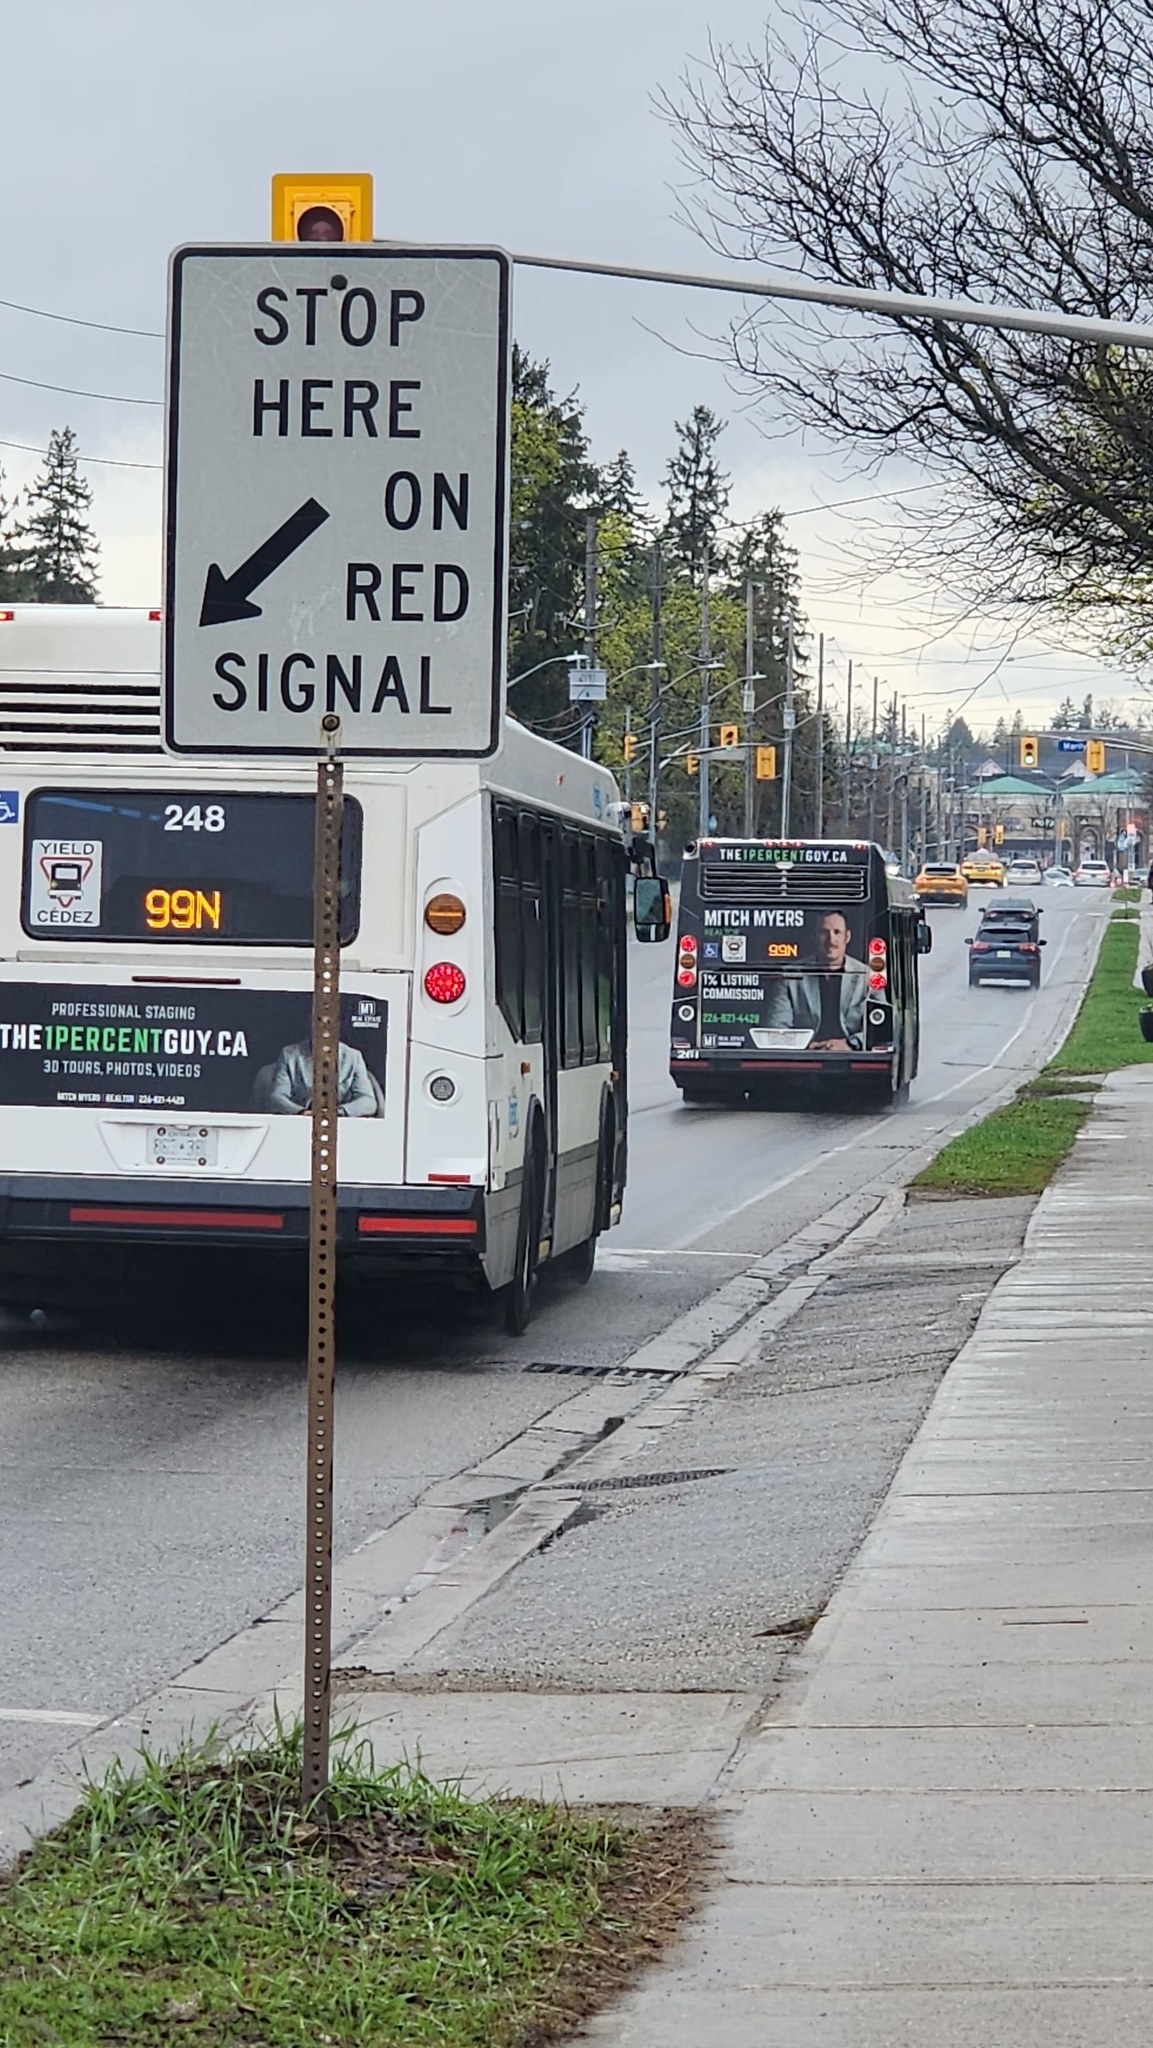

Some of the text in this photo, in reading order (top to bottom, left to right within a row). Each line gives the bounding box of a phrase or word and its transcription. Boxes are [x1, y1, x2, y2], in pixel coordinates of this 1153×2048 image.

[254, 286, 426, 347] STOP
[253, 378, 421, 438] HERE
[384, 471, 469, 531] ON
[346, 563, 470, 622] RED
[212, 651, 453, 714] SIGNAL
[163, 804, 226, 832] 248
[40, 843, 95, 855] YIELD
[719, 848, 848, 863] THE1PERCENTGUY.CA
[37, 908, 94, 924] CÉDEZ
[145, 889, 221, 929] 99N
[704, 909, 804, 927] MITCH MYERS
[768, 943, 798, 957] 99N
[703, 973, 760, 986] 1% LISTING
[703, 988, 764, 1000] COMMISSION
[51, 1002, 196, 1020] PROFESSIONAL STAGING
[0, 1024, 249, 1057] THE1PERCENTGUY.CA
[43, 1059, 60, 1074] 3D
